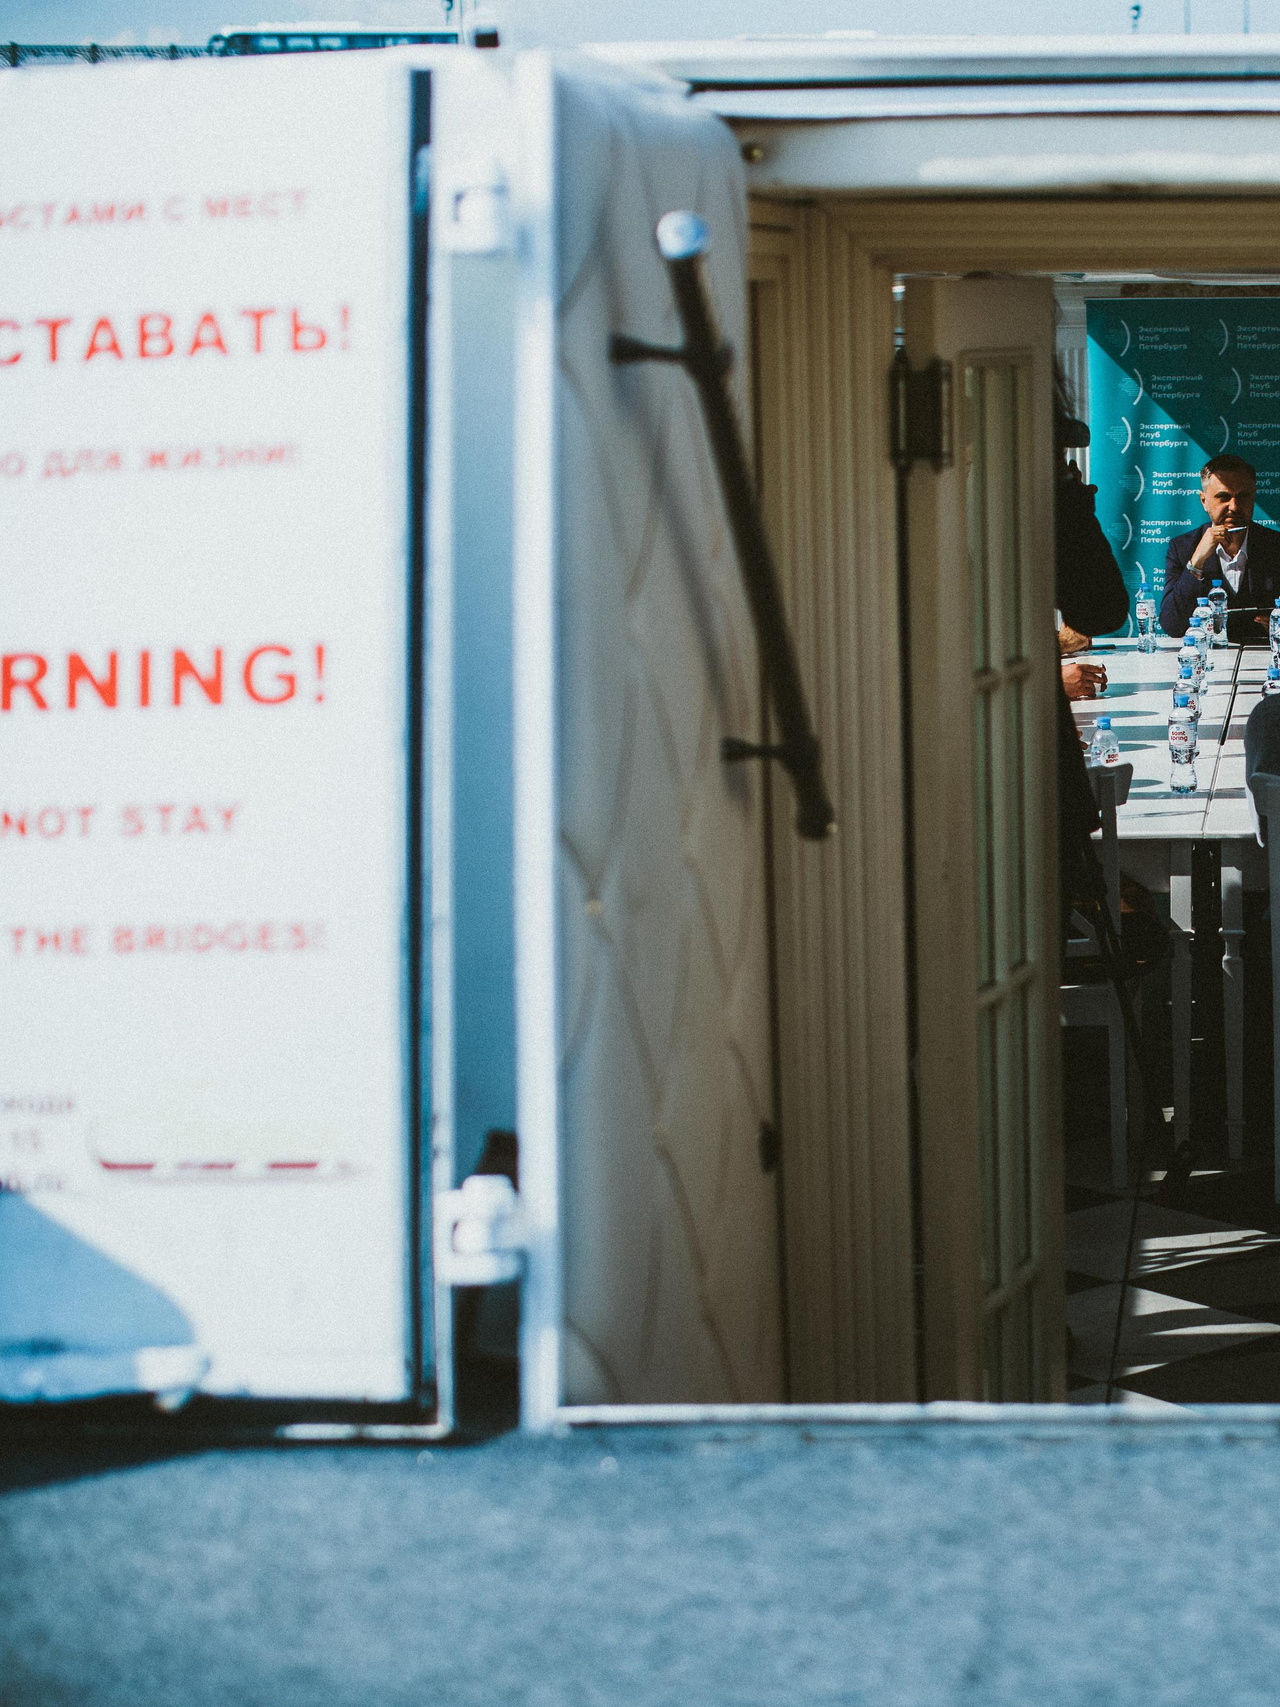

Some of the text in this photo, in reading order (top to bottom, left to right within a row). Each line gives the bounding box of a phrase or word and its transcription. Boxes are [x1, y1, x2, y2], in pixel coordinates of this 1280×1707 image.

[0, 200, 147, 230] СТАМИ
[1138, 326, 1189, 334] Экспертный
[1138, 334, 1159, 342] Клуб
[1138, 343, 1187, 351] Петербурга
[1152, 374, 1202, 382] Экспертный
[1152, 382, 1172, 390] Клуб
[1250, 382, 1270, 390] Клуб
[1152, 391, 1200, 399] Петербурга
[1140, 423, 1191, 431] Экспертный
[1140, 440, 1188, 448] Петербурга
[0, 644, 324, 710] RNING!
[119, 803, 242, 838] STAY
[9, 924, 89, 955] THE
